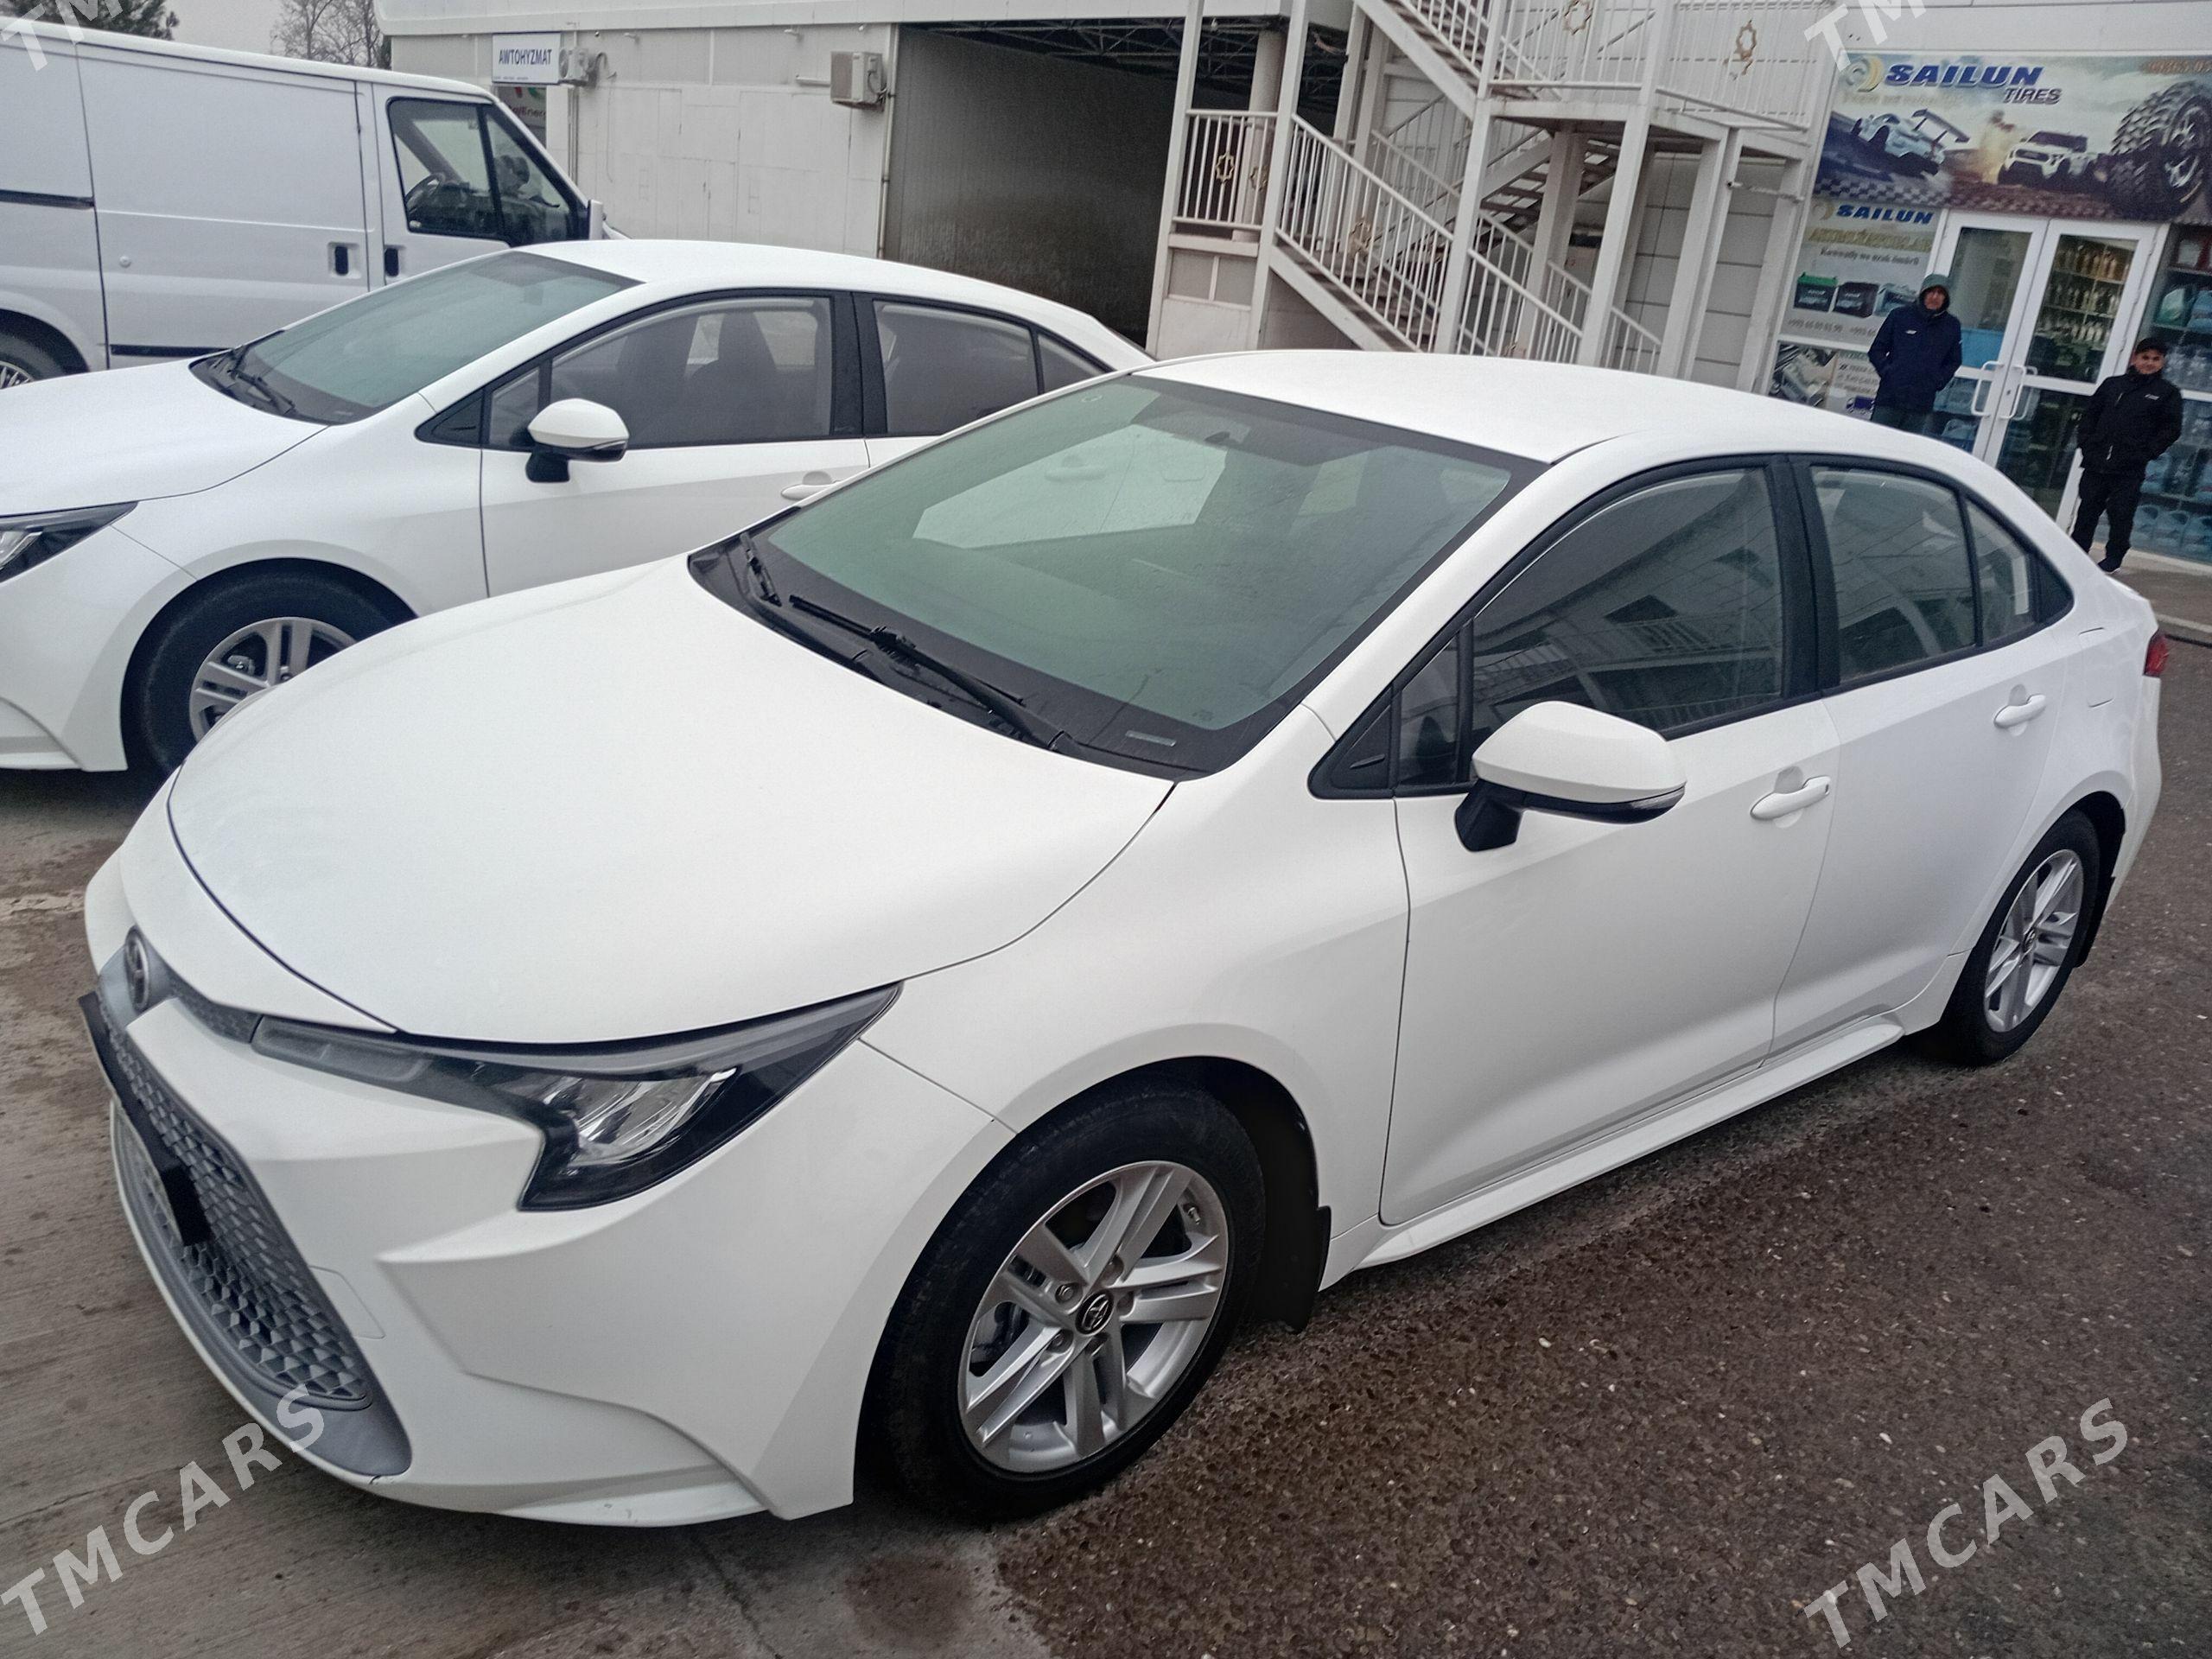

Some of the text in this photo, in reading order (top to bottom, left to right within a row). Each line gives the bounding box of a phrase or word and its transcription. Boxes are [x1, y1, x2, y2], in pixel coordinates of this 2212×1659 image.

[499, 48, 552, 66] AWTOHYZMAT
[1884, 64, 2045, 87] SAILUN
[2003, 87, 2063, 105] TIRES
[1836, 204, 1934, 225] SAILUN
